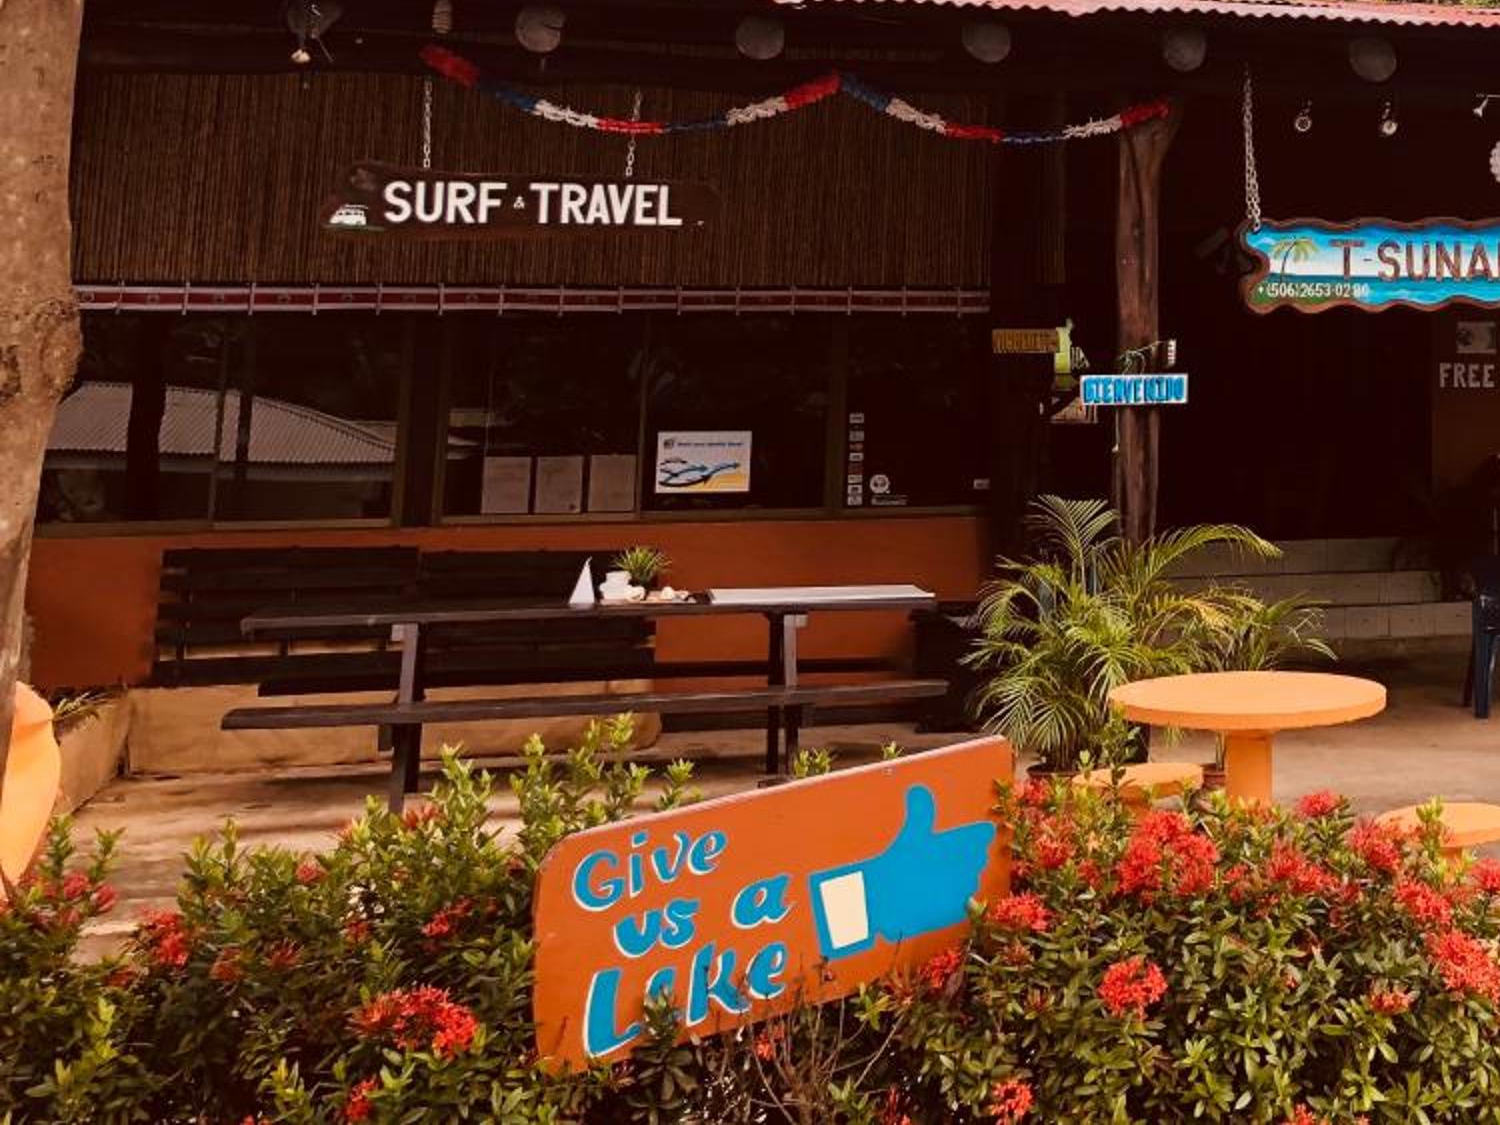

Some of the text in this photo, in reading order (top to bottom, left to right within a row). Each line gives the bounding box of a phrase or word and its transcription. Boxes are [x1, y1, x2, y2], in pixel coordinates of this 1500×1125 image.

[383, 180, 508, 224] SURF
[529, 182, 683, 227] TRAVEL
[1439, 362, 1496, 388] FREE
[572, 829, 729, 912] Give
[613, 873, 795, 959] us a
